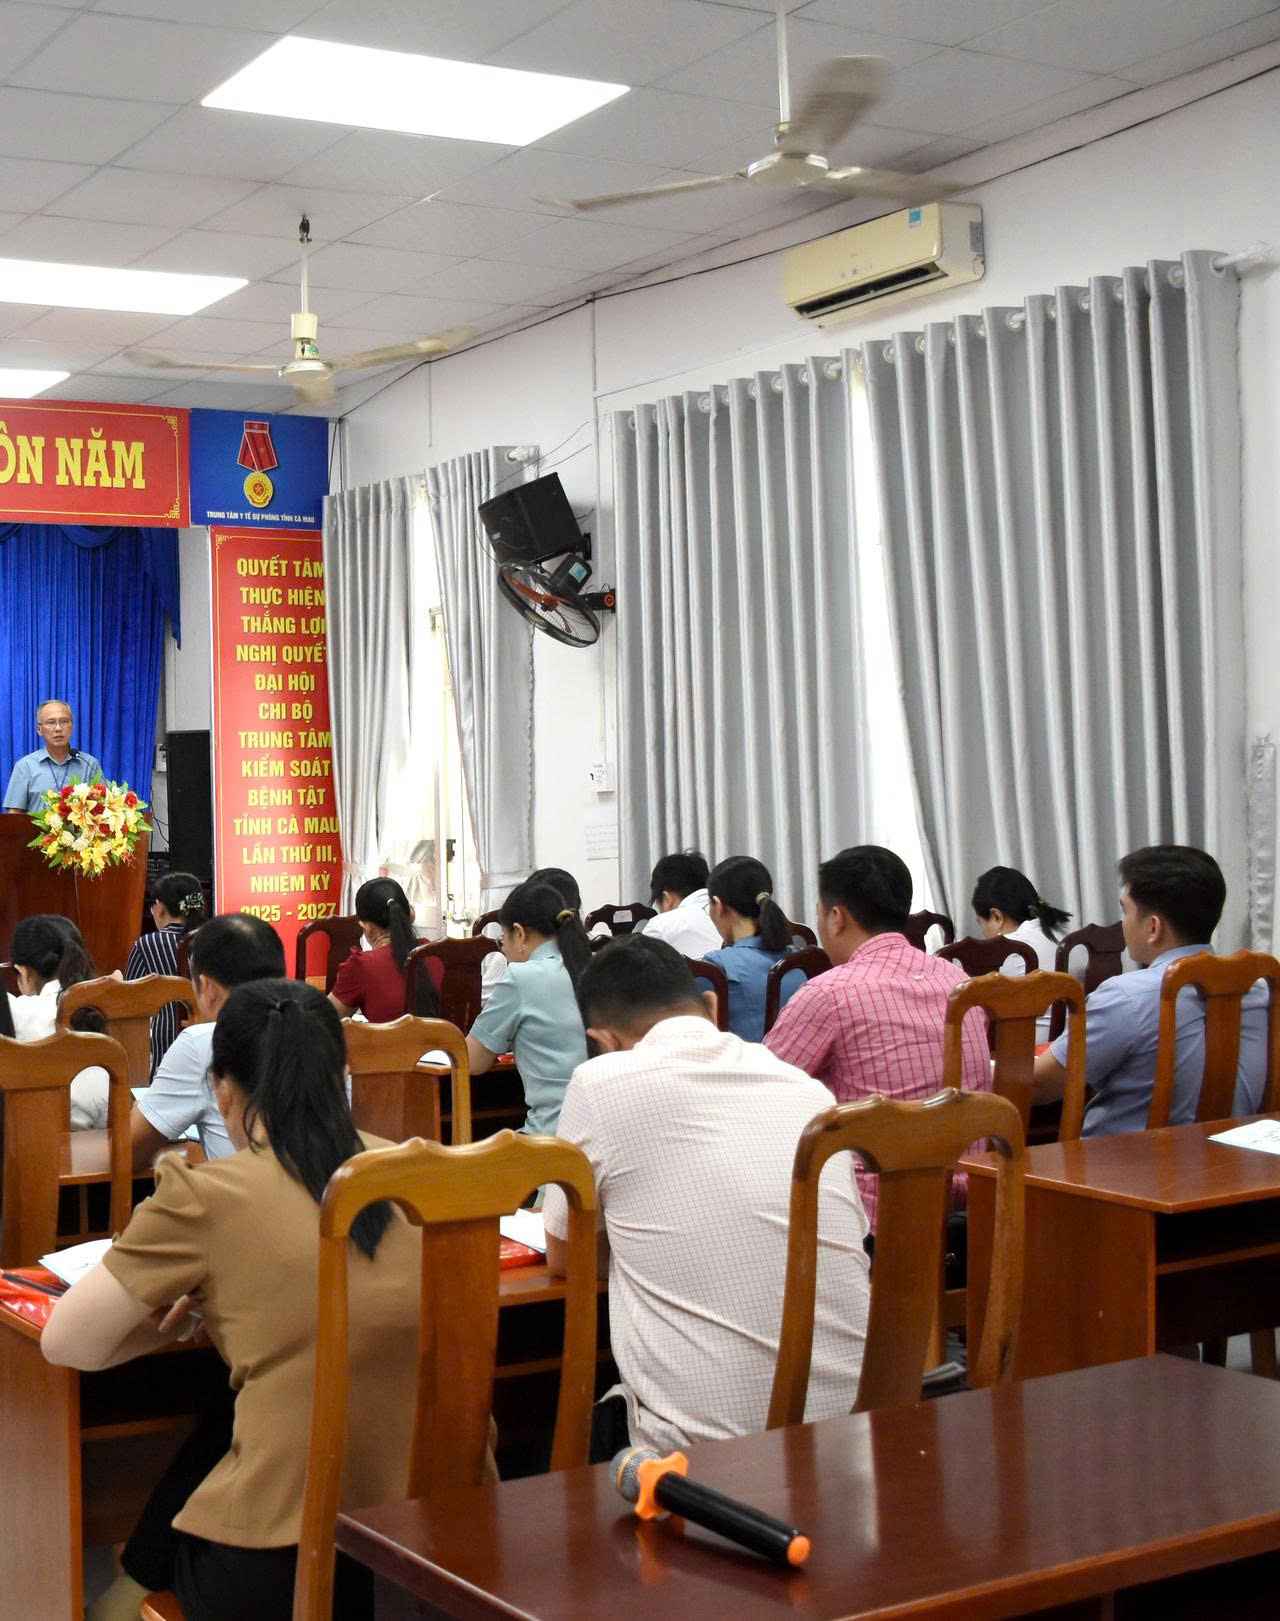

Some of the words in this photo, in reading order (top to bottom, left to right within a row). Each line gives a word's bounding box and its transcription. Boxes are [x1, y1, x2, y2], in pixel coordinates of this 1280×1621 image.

[56, 427, 146, 489] NĂM
[207, 511, 225, 519] TRUNG
[236, 555, 288, 577] QUYẾT
[240, 587, 282, 608] THỰC
[287, 586, 325, 609] HIỆN
[241, 610, 296, 634] THẮNG
[301, 616, 326, 637] LỢI
[236, 645, 277, 666] NGHỊ
[282, 641, 327, 664] QUYẾ
[255, 673, 283, 694] ĐẠI
[288, 672, 315, 695] HỘI
[259, 703, 286, 720] CHI
[291, 700, 313, 723] BỘ
[238, 731, 293, 748] TRUNG
[298, 728, 332, 748] TÂM
[241, 753, 284, 777] KIỂM
[289, 756, 331, 777] SOÁT
[248, 785, 292, 810] BỆNH
[297, 785, 326, 809] TẬT
[233, 813, 272, 836] TỈNH
[277, 815, 300, 835] CÀ
[304, 817, 339, 834] MAU
[242, 841, 275, 865] LẦN
[280, 843, 313, 863] THỨ
[316, 845, 337, 864] III,
[250, 872, 305, 896] NHIỆM
[310, 870, 331, 891] KỲ
[297, 902, 337, 921] 2027
